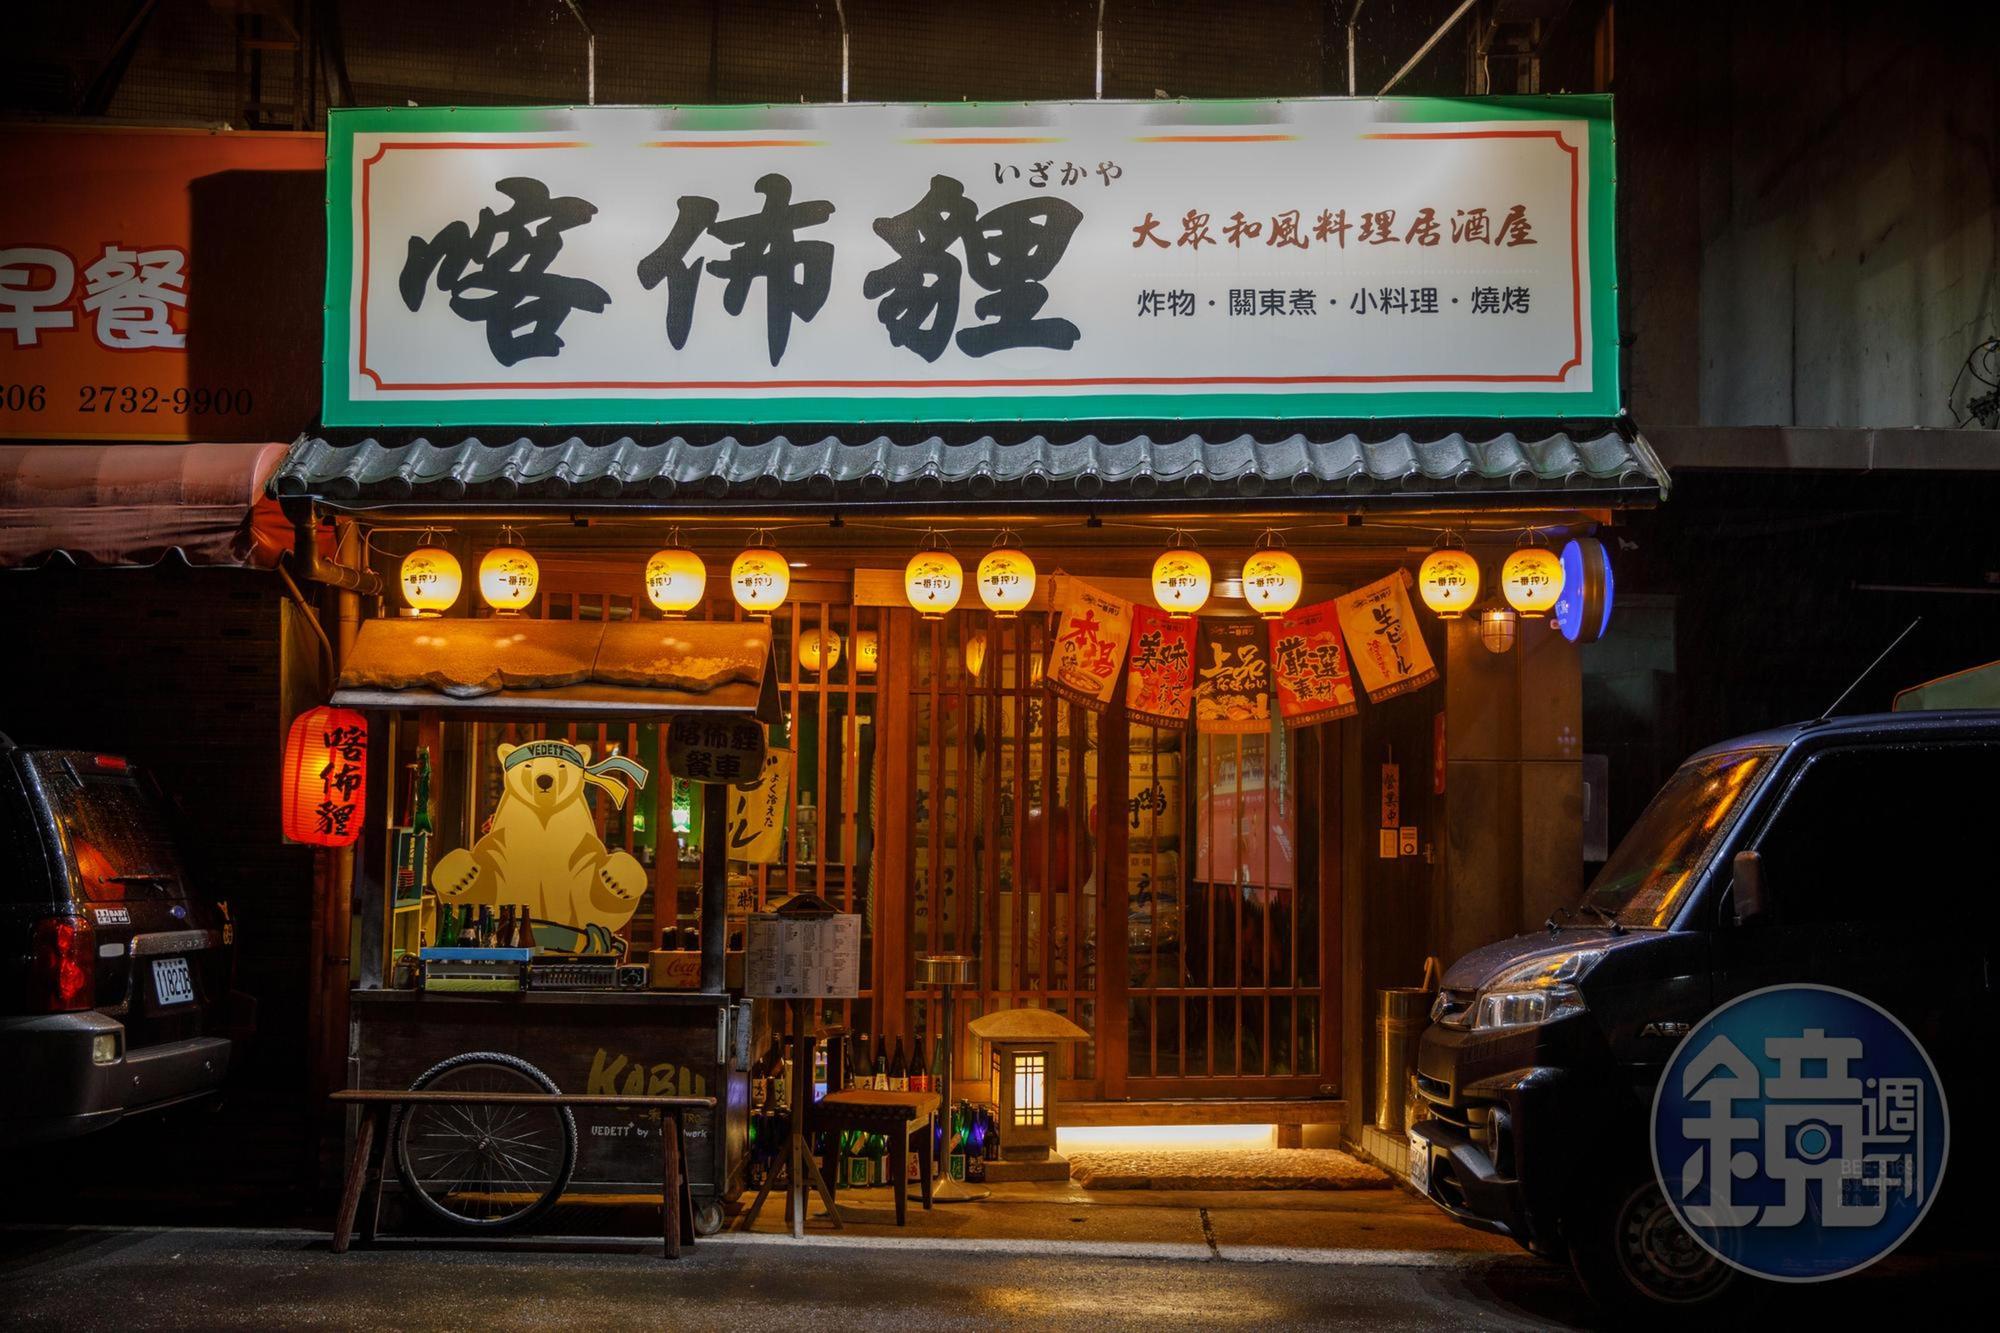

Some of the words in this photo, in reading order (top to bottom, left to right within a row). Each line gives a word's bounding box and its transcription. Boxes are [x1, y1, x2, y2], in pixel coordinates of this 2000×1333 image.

[993, 160, 1124, 188] いざかや
[0, 246, 188, 349] 早餐
[0, 384, 46, 411] 06
[79, 386, 252, 415] 2732-9900
[528, 744, 565, 756] VEDETT
